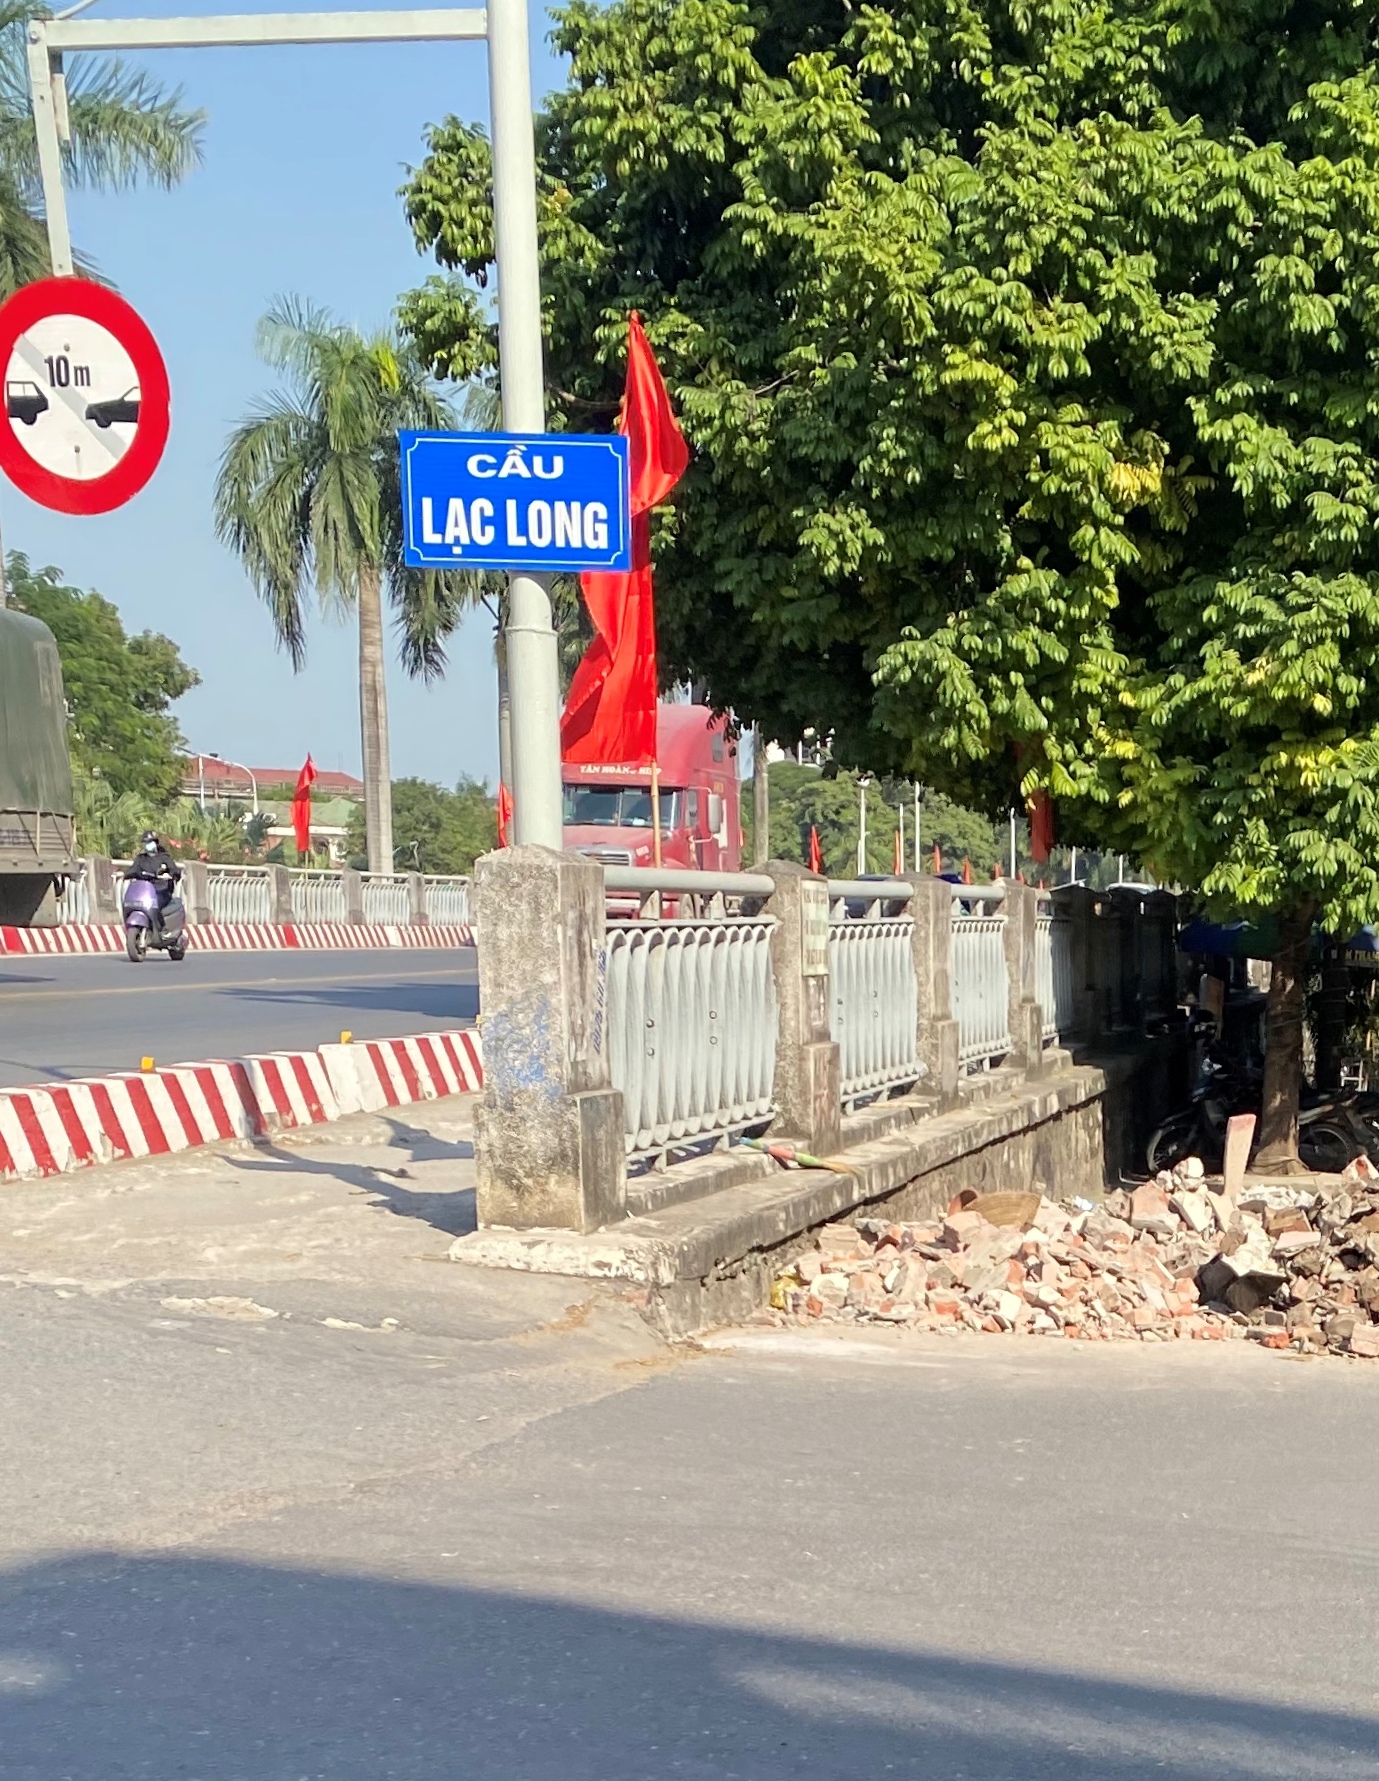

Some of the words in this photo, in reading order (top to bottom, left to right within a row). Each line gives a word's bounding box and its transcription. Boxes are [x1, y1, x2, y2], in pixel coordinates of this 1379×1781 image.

[466, 444, 564, 479] CẦU
[422, 497, 495, 554] LẠC
[506, 499, 609, 549] LONG
